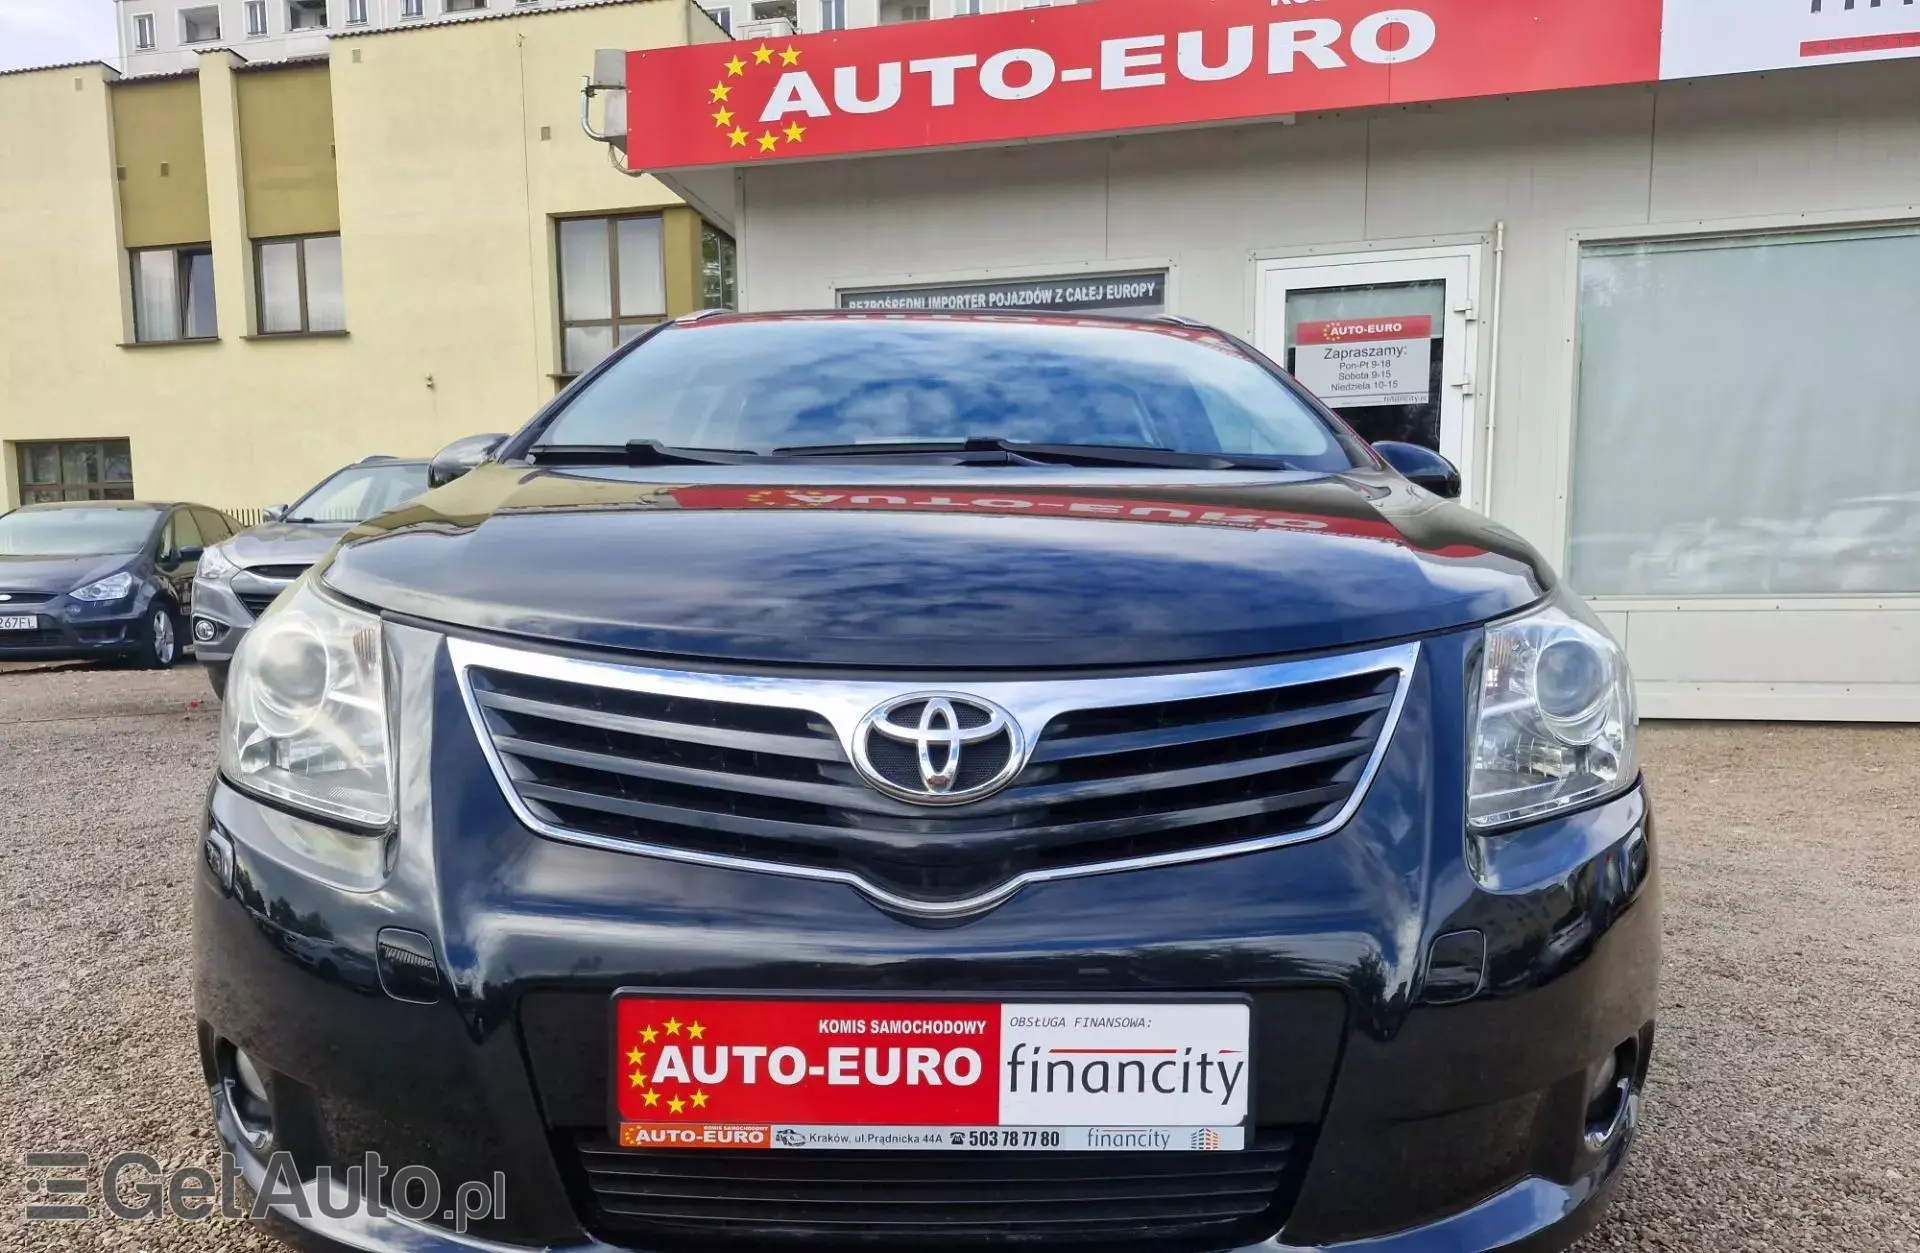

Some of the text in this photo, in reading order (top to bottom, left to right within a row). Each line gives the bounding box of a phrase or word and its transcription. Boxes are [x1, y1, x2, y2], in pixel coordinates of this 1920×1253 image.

[759, 9, 1437, 122] AUTO-EURO
[928, 293, 986, 309] IMPORTER
[989, 287, 1052, 307] POJAZDÓW
[1055, 289, 1063, 303] Z
[1065, 285, 1103, 302] CAŁEJ
[1106, 282, 1156, 299] EUROPY
[1330, 322, 1402, 336] AUTO-EURO
[1323, 345, 1407, 361] Zapraszamy:
[1339, 360, 1391, 370] Pon-Pt 9-18
[1338, 370, 1391, 381] Sobota 9-15
[1331, 380, 1399, 392] Niedziela 10-15
[818, 1020, 986, 1035] KOMIS SAMOCHODOWY
[1010, 1016, 1153, 1028] OBSŁUGA FINANSOWA:
[651, 1046, 982, 1086] AUTO-EURO
[1007, 1043, 1244, 1105] financity
[635, 1129, 764, 1144] AUTO-EURO
[809, 1131, 1060, 1147] Kraków, ul.Prądnicka 44A 503 78 77 80
[1087, 1128, 1171, 1151] financity
